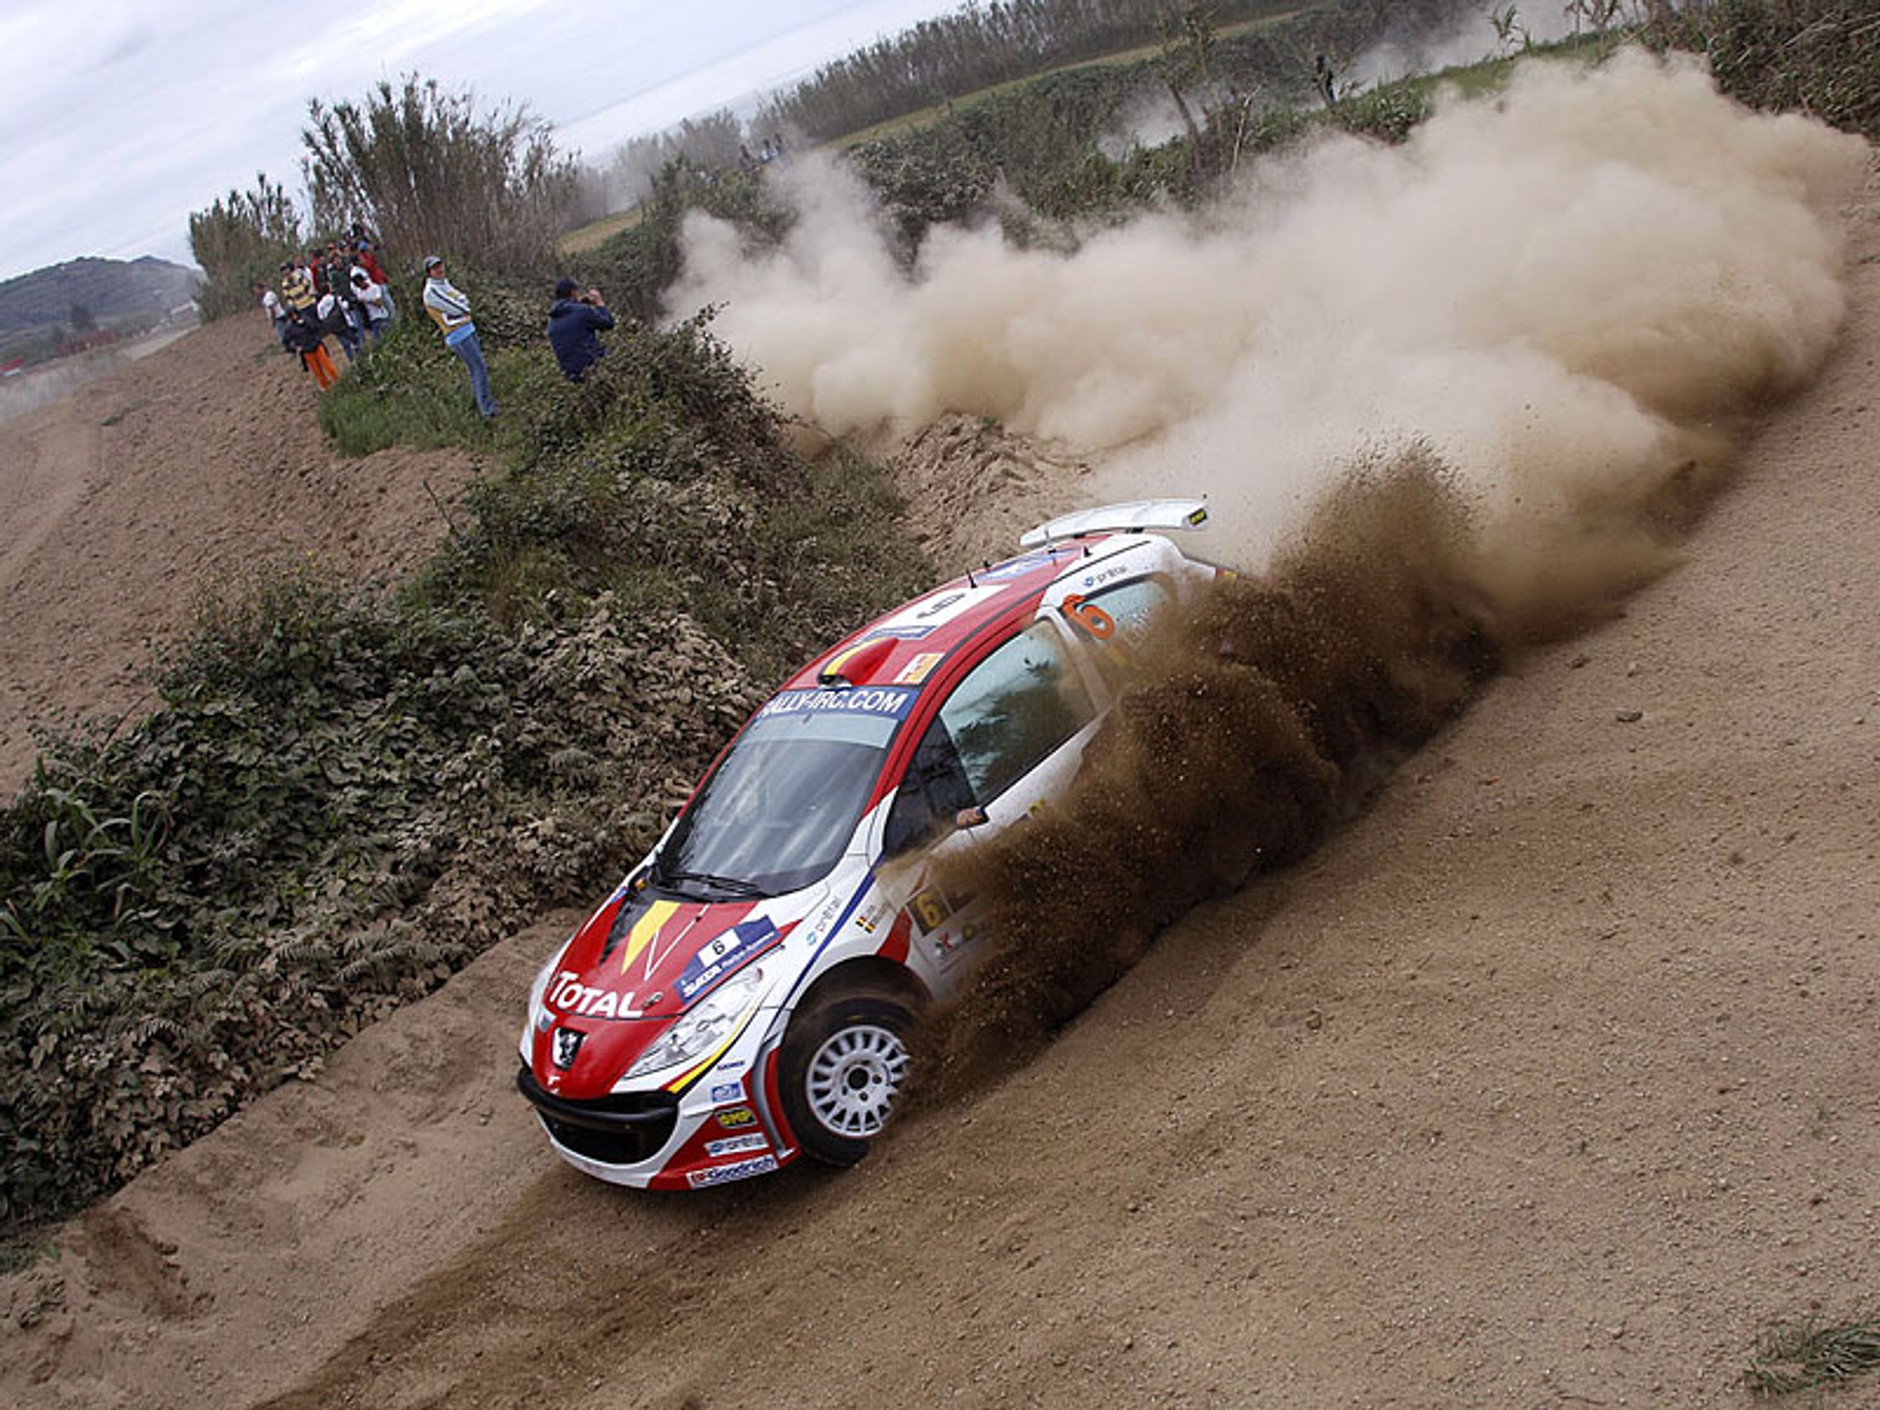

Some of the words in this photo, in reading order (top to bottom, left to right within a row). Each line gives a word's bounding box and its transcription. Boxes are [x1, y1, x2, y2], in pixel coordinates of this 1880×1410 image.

[1062, 594, 1115, 640] 6
[916, 891, 940, 928] 6
[712, 940, 725, 954] 6
[550, 971, 644, 1019] TOTAL
